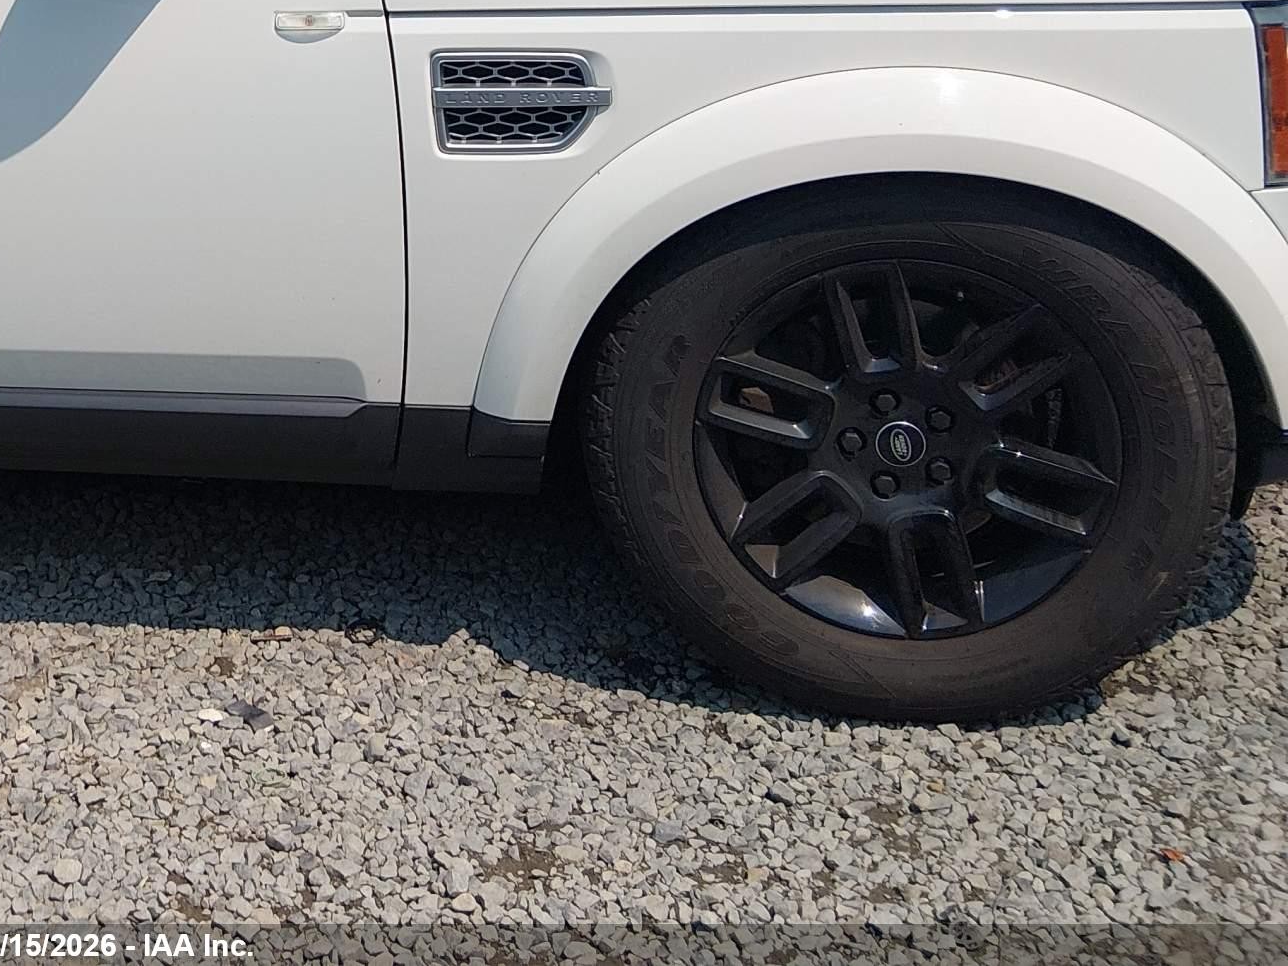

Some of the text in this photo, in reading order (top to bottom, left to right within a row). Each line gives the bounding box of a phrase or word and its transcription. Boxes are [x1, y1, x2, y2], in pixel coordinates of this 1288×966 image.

[445, 91, 599, 104] LAND ROVER
[644, 333, 801, 657] GOODYEAR
